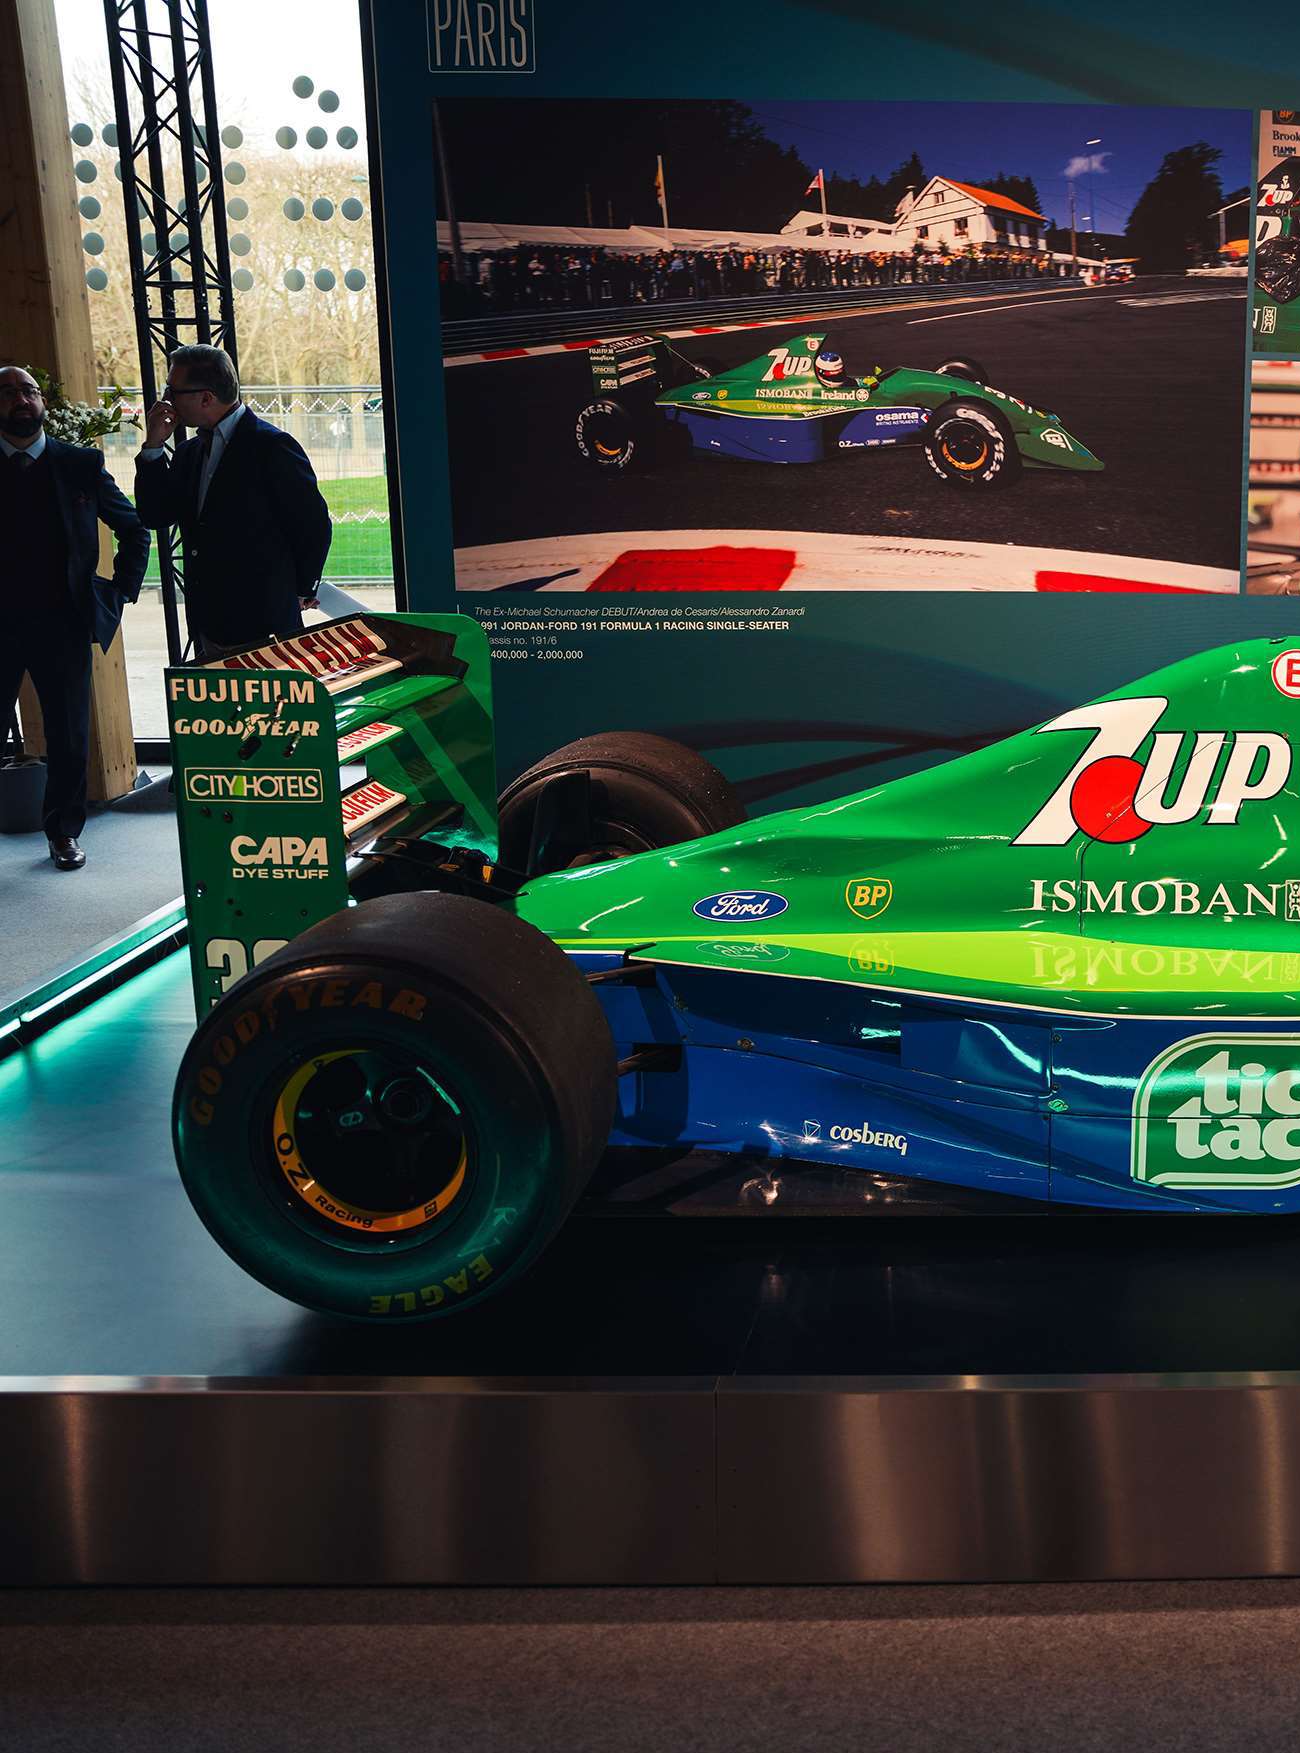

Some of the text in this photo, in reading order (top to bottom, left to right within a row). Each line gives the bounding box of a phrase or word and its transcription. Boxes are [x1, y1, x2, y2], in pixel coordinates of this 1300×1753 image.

[434, 0, 528, 67] PARIS
[761, 348, 812, 381] 7UP
[820, 390, 856, 401] Ireland
[875, 411, 919, 422] osama
[475, 606, 806, 618] The Ex-Michael Schumacher DEBUT/Andrea de Cesaris/Alessandro Zanardi
[500, 622, 578, 631] JORDAN-FORD
[580, 622, 597, 631] 191
[600, 621, 653, 631] FORMULA
[655, 622, 660, 631] 1
[663, 621, 704, 631] RACING
[706, 621, 790, 631] SINGLE-SEATER
[488, 636, 558, 645] assis no. 191/6
[537, 650, 584, 660] 2,000,000
[1013, 695, 1293, 846] 7UP
[230, 835, 328, 866] CAPA
[232, 868, 329, 880] DYE STUFF
[711, 894, 770, 916] Ford
[853, 885, 887, 906] BP
[1029, 878, 1286, 917] ISMOBAN
[190, 978, 429, 1128] GOODYEAR
[315, 1194, 374, 1229] Racing
[368, 1253, 495, 1315] EAGLE
